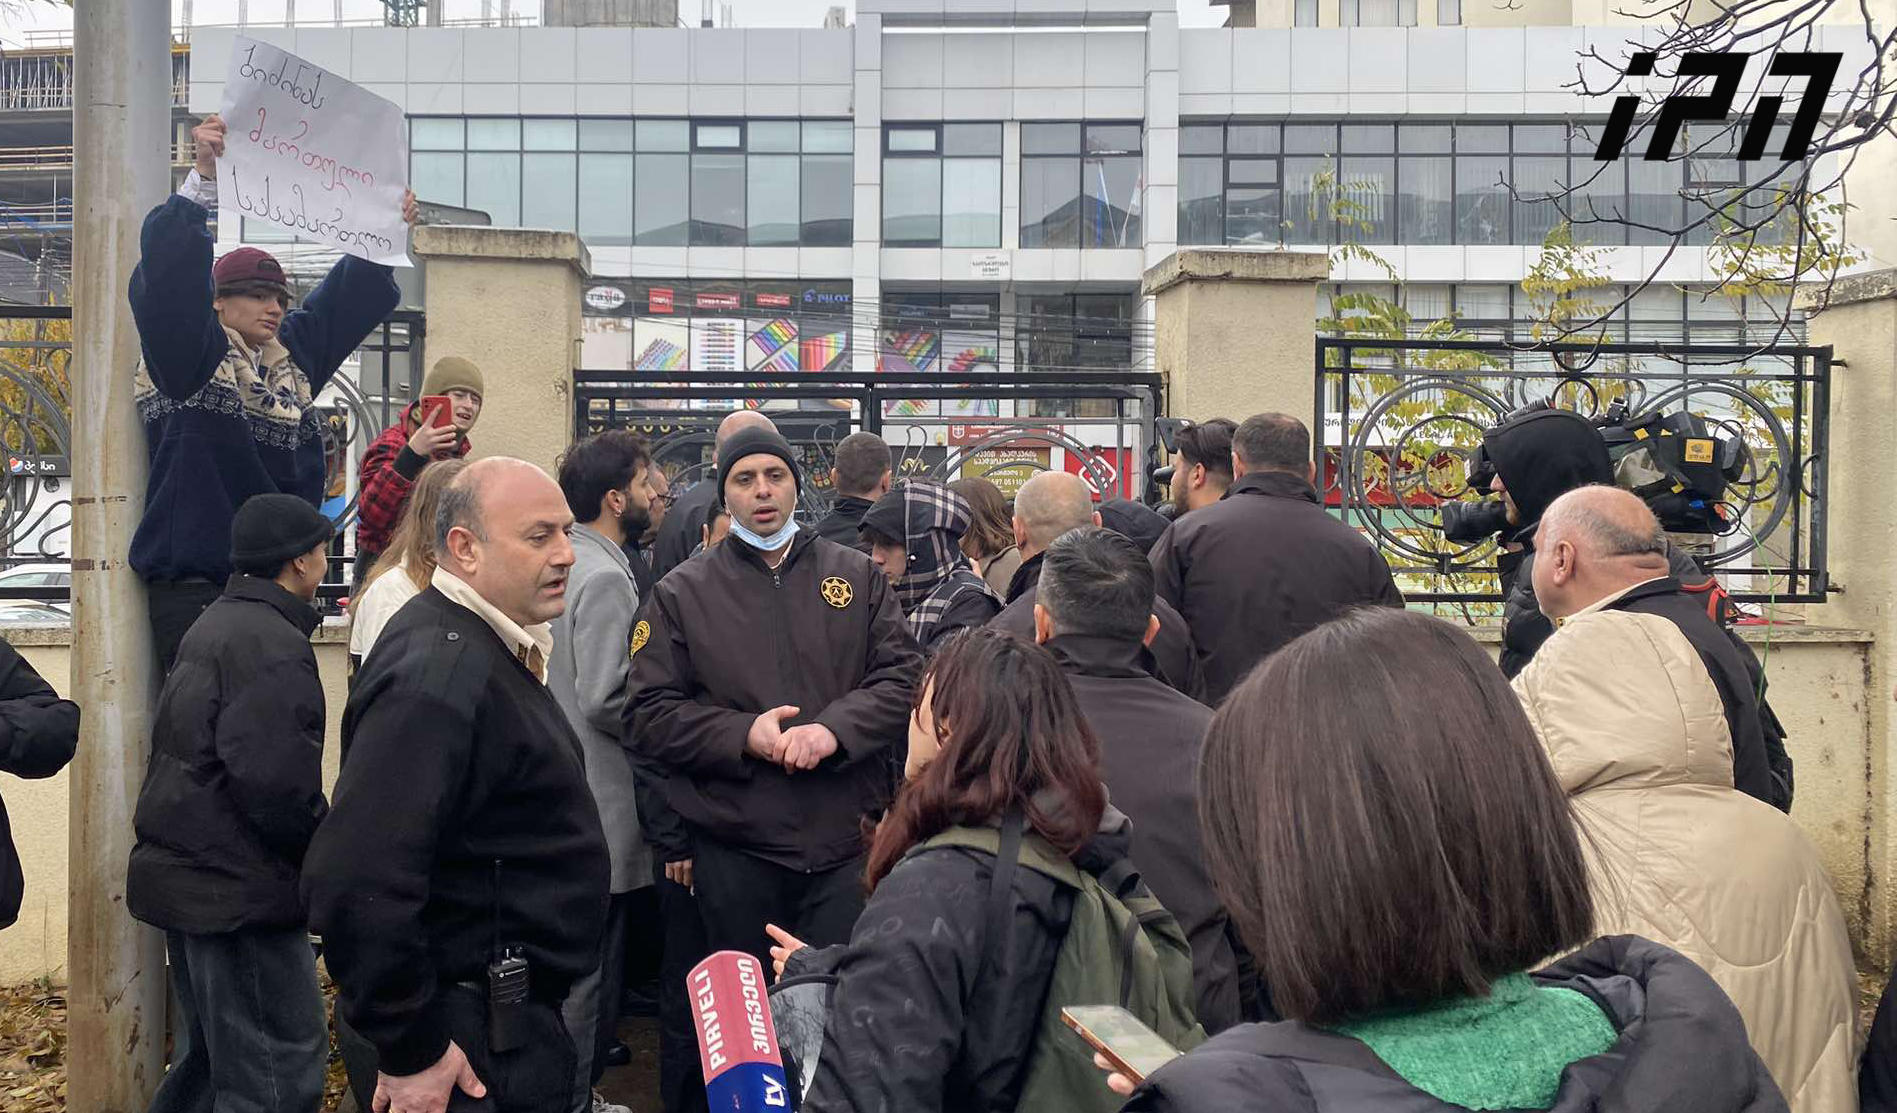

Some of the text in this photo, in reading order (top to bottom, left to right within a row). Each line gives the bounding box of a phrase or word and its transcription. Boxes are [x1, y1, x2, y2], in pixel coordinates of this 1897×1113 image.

[240, 44, 325, 110] ბიძინას
[249, 106, 374, 198] მართული
[231, 164, 392, 262] სასამართლო
[24, 460, 56, 474] პესი
[694, 969, 728, 1071] PIRVELI
